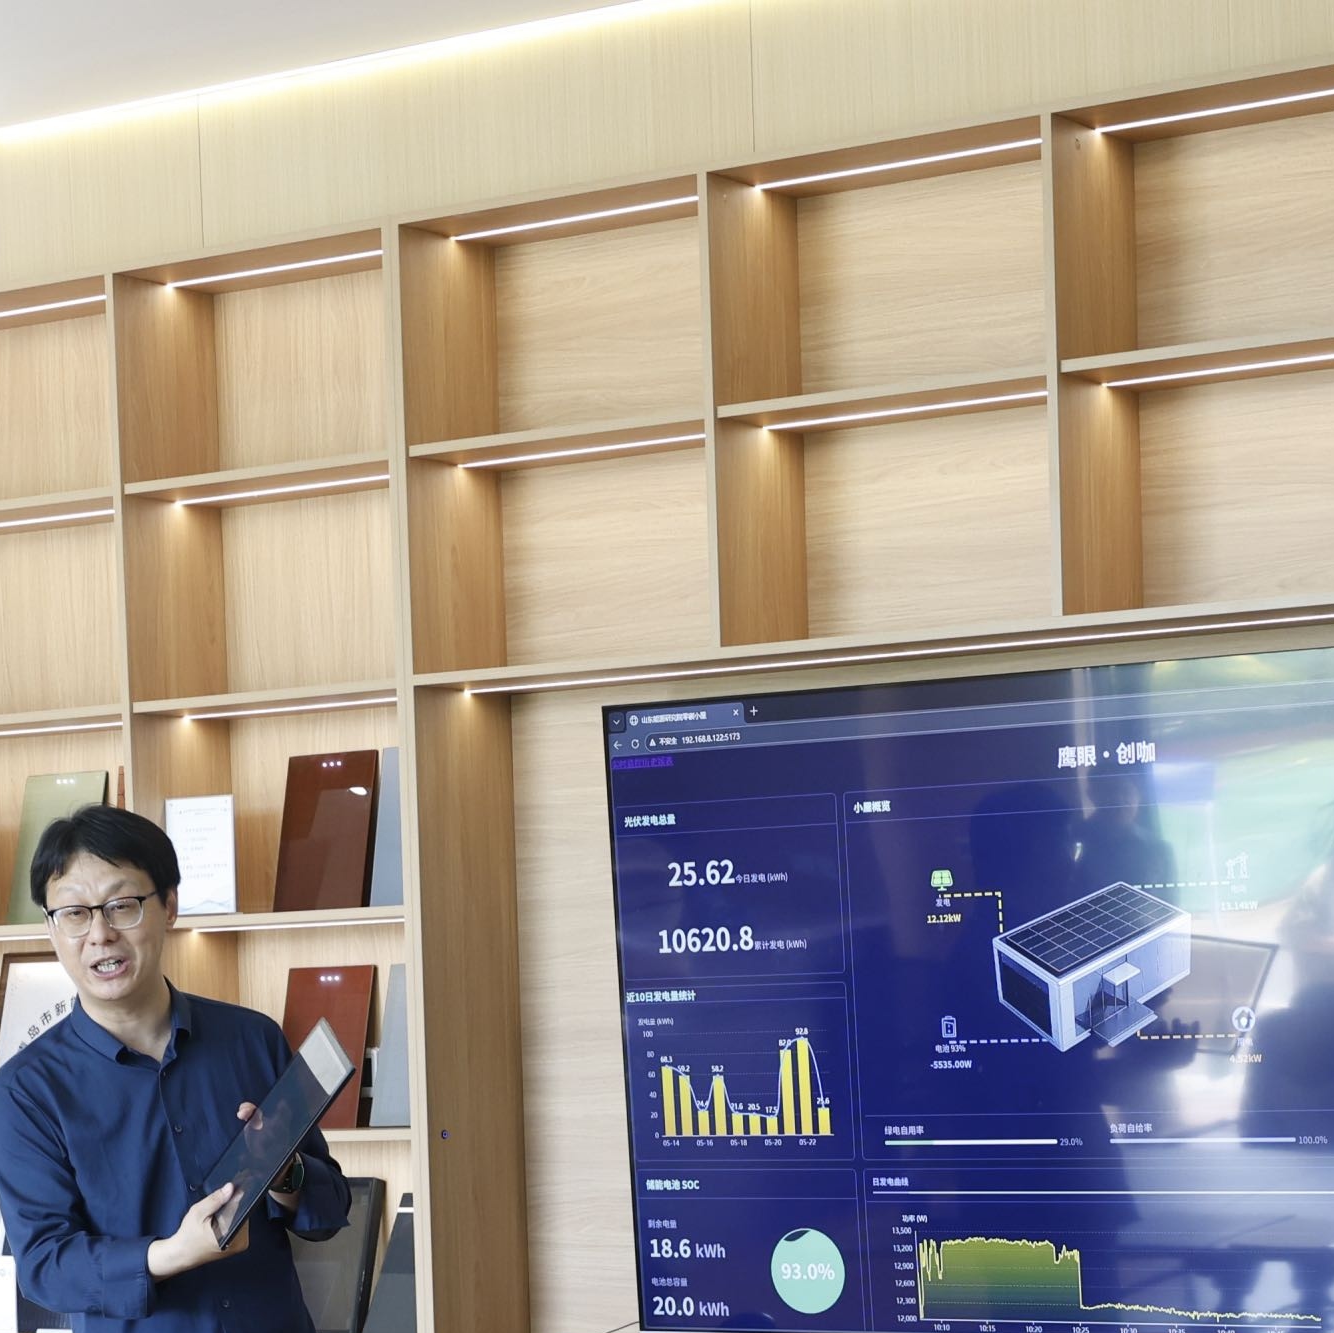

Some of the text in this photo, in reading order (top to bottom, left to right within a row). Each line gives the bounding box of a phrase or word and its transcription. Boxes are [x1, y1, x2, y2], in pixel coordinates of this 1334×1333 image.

[659, 733, 741, 745] 不安全 192.168.8.122:5173
[853, 800, 891, 814] 小屋概览
[624, 814, 676, 827] 光伏发电总量
[668, 859, 788, 887] 25.62 今日发电 (kWh)
[936, 899, 950, 907] 发电
[927, 914, 961, 924] 12.12kW
[658, 926, 807, 954] 10620.8 累计发电 (kWh)
[627, 990, 696, 1003] 近10日发电量统计
[657, 1018, 674, 1026] (kWh)
[935, 1044, 966, 1053] 电池 93%
[930, 1060, 972, 1069] -5535.00W
[884, 1125, 925, 1137] 绿电自用率
[1110, 1123, 1153, 1134] 负荷自给率
[663, 1139, 679, 1147] 05-14
[697, 1139, 713, 1147] 05-16
[799, 1138, 816, 1146] 05-22
[1059, 1136, 1083, 1147] 29.0%
[1298, 1136, 1328, 1145] 100.0%
[646, 1180, 700, 1191] 储能电池 SOC
[873, 1177, 909, 1187] 日发电曲线
[648, 1219, 677, 1228] 剩余电量
[916, 1214, 927, 1223] (W)
[892, 1227, 912, 1235] 13,500
[650, 1238, 726, 1258] 18.6 kWh
[893, 1244, 913, 1252] 13,200
[894, 1262, 914, 1270] 12,900
[781, 1263, 835, 1280] 93.0%
[651, 1277, 688, 1287] 电池总容量
[895, 1279, 915, 1288] 12,600
[896, 1297, 916, 1305] 12,300
[653, 1297, 730, 1317] 20.0 kWh
[897, 1314, 917, 1323] 12,000
[934, 1323, 950, 1331] 10:10
[979, 1324, 996, 1333] 10:15
[1026, 1325, 1043, 1333] 10:20
